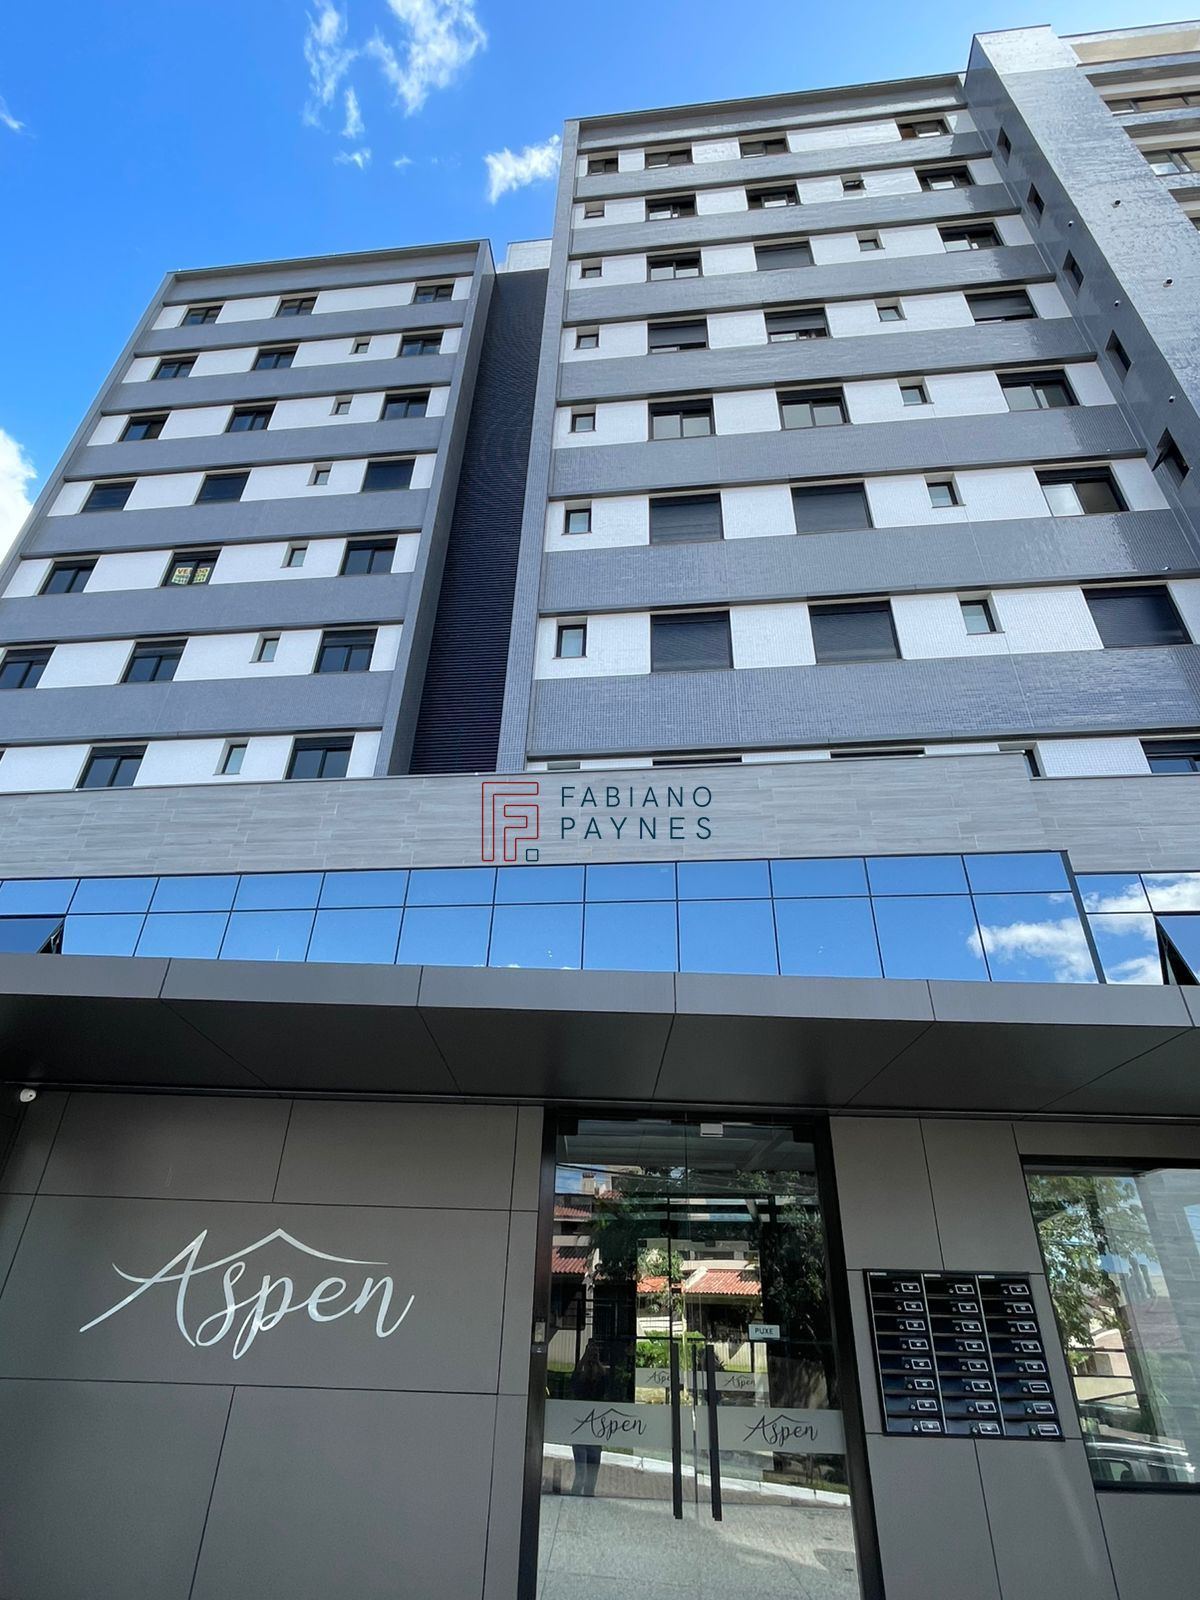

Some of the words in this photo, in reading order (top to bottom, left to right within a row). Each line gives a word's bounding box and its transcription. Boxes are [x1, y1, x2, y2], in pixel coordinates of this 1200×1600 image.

[79, 1228, 415, 1359] Aspen
[570, 1407, 647, 1440] Aspen
[743, 1414, 818, 1447] Aspen
